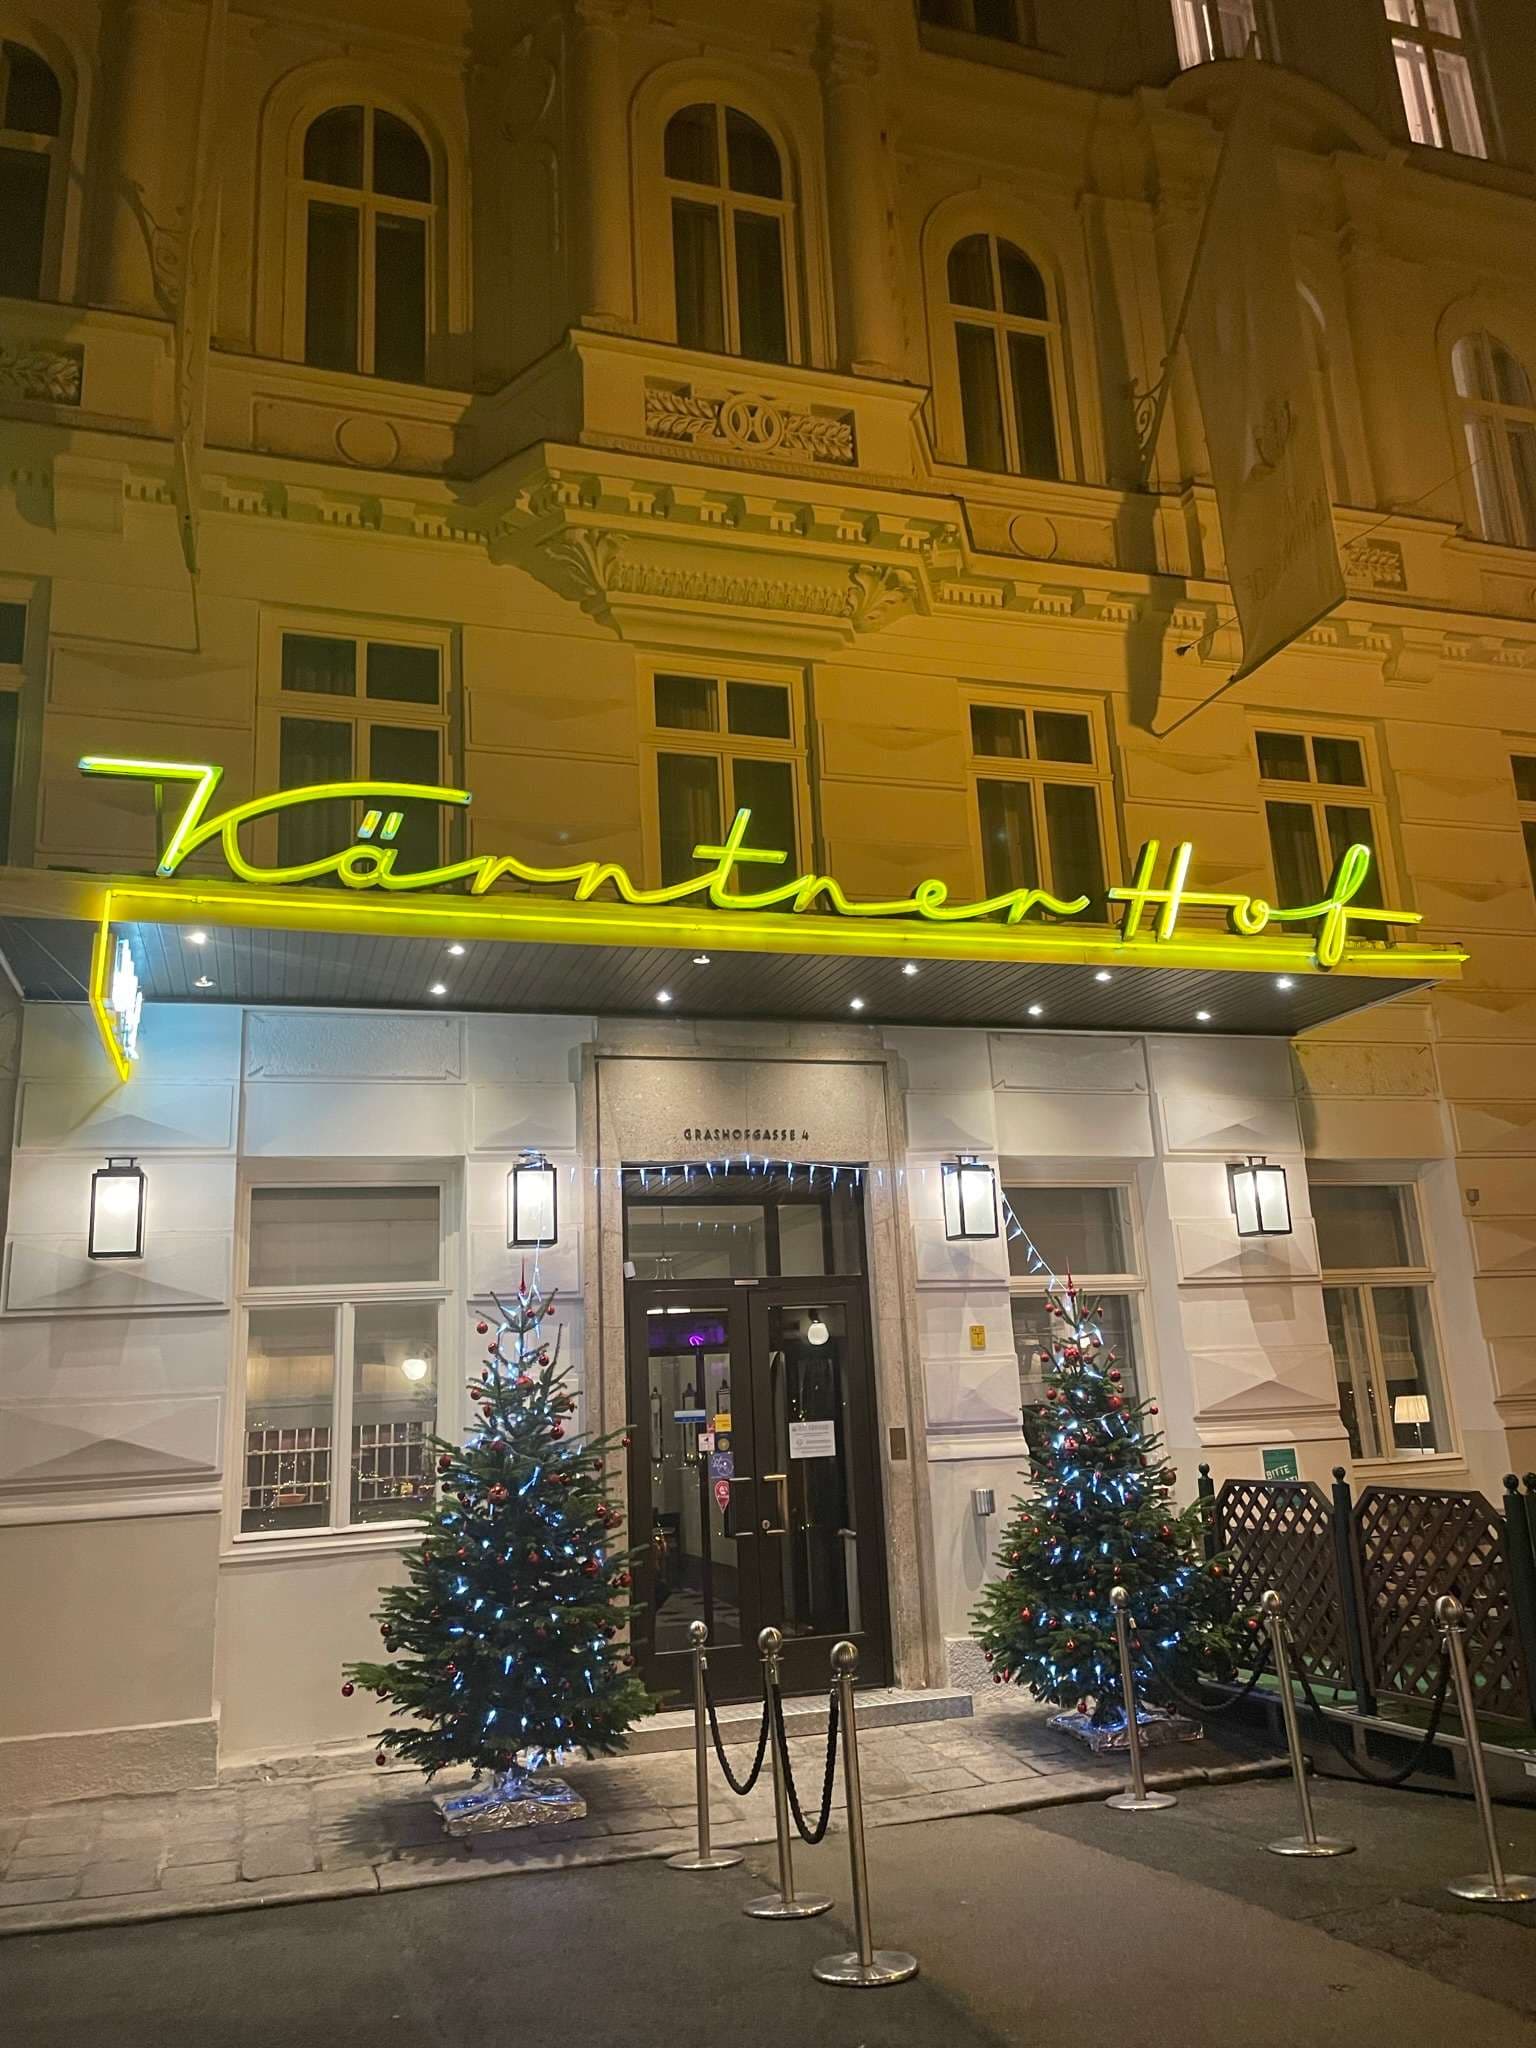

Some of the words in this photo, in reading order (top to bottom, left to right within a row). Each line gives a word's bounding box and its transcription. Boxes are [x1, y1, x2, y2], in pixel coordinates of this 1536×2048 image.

[78, 754, 1090, 924] Kärntner
[1108, 840, 1423, 968] Hof
[683, 1128, 796, 1142] GRASHOFGASSE
[801, 1128, 810, 1142] 4
[1265, 1464, 1291, 1480] BITTE
